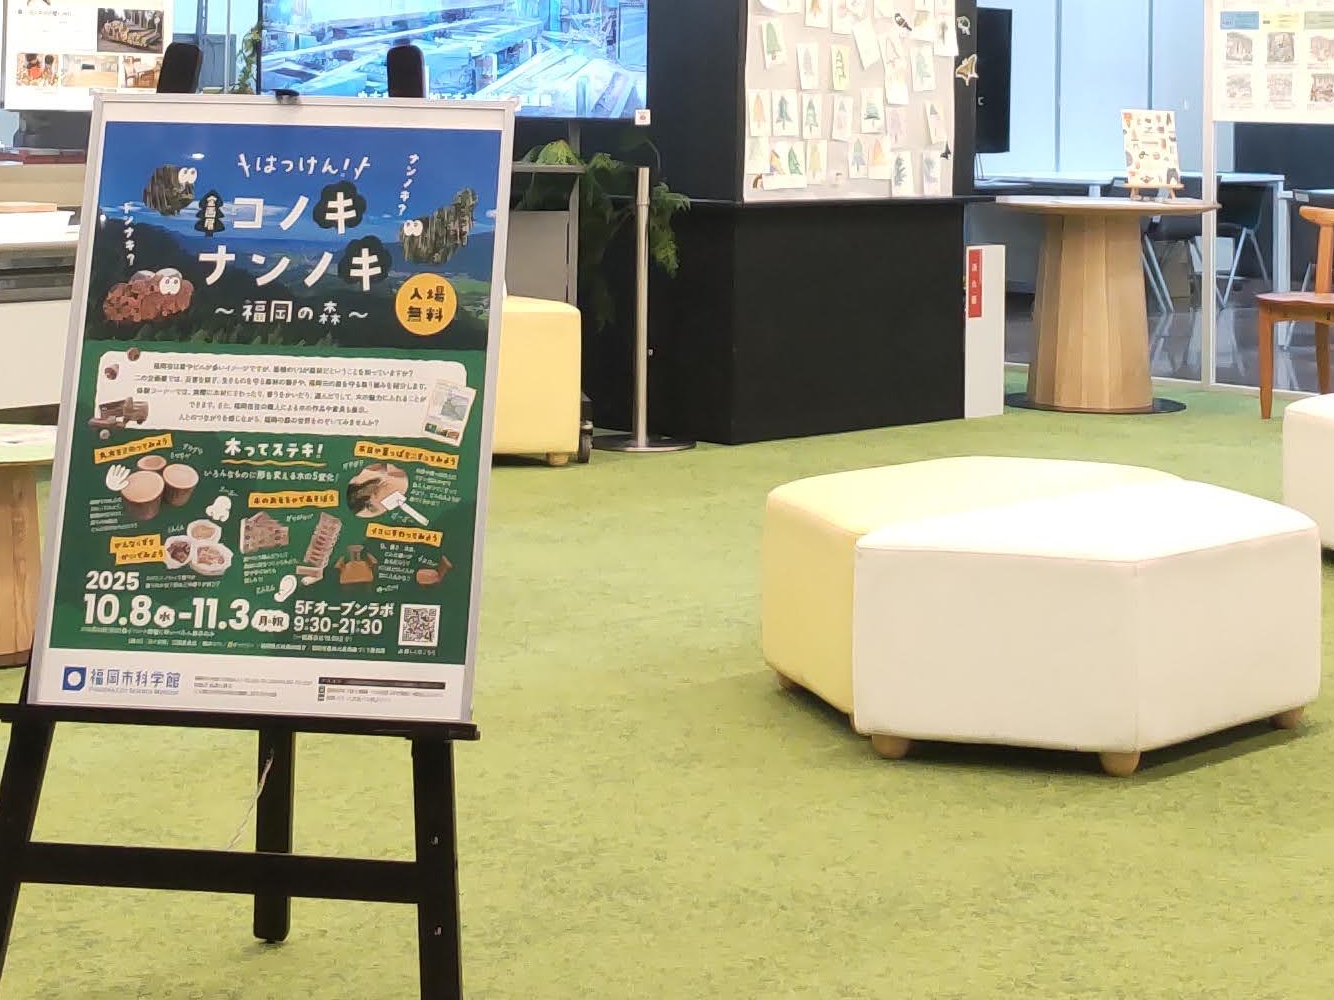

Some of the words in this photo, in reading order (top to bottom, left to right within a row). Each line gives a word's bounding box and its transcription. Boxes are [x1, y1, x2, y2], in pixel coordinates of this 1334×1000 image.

[255, 155, 351, 178] はっけん!
[397, 153, 420, 216] ナンノキ?
[234, 191, 357, 235] コノキ
[198, 245, 382, 292] ナンノキ
[410, 285, 446, 303] 入場
[407, 305, 444, 322] 無料
[224, 437, 324, 459] 木ってステキ!
[85, 570, 140, 591] 2025
[294, 600, 395, 618] 5Fオープンラボ
[90, 668, 181, 689] 福岡市科学館
